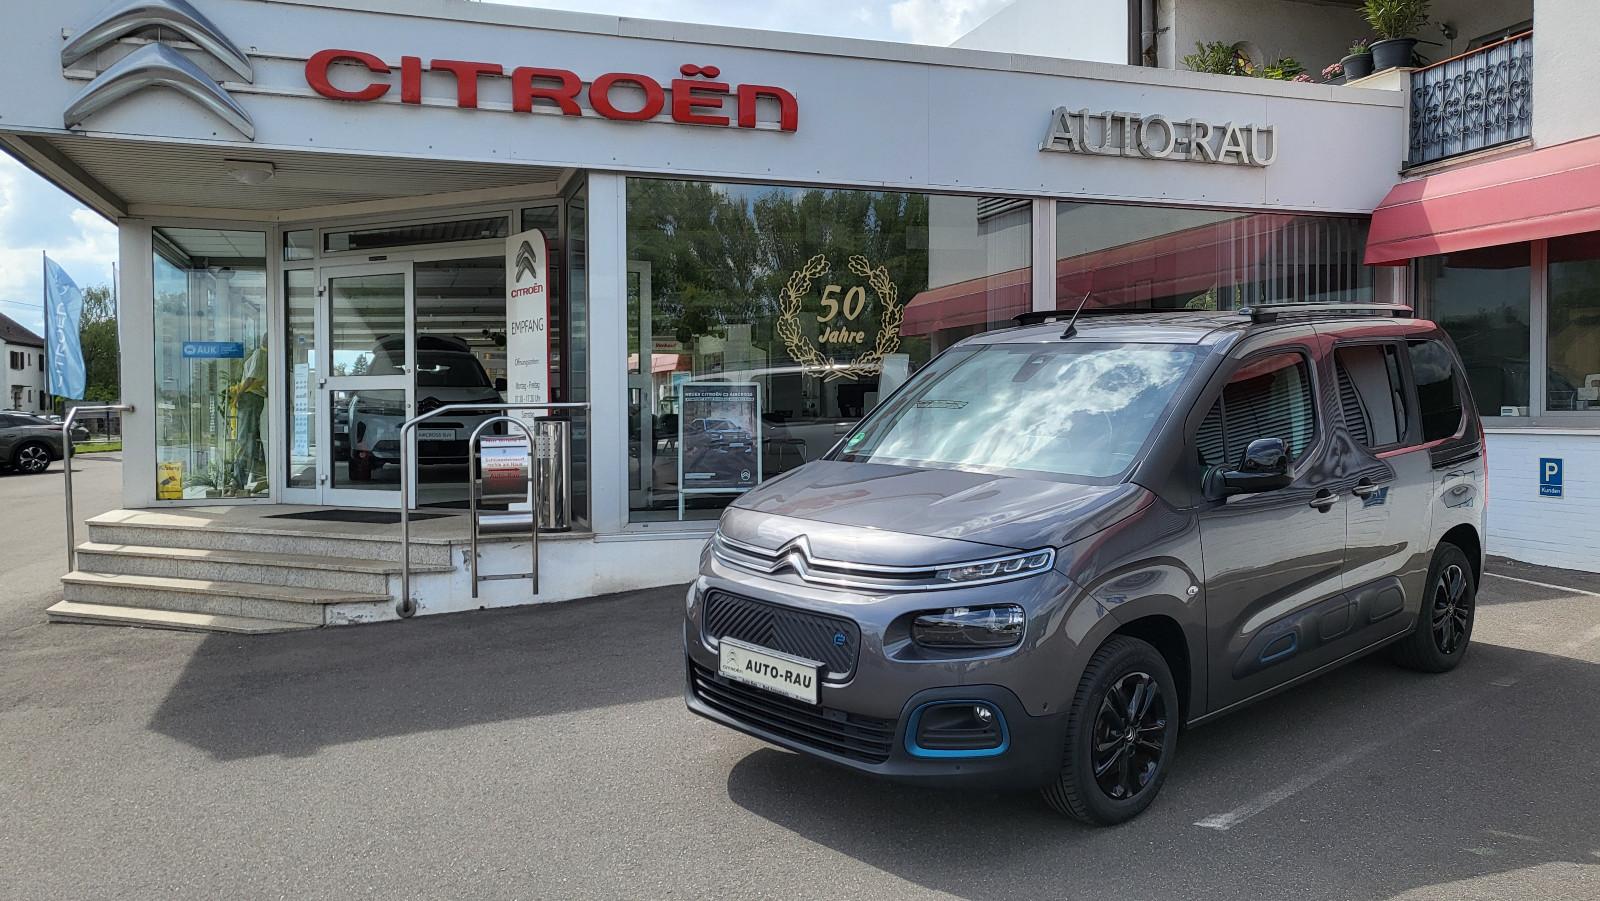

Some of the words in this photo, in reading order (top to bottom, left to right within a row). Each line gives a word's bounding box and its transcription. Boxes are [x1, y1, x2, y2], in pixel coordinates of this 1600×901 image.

[305, 49, 798, 132] CITROËN
[1038, 105, 1280, 168] AUTO-RAU
[511, 282, 544, 298] CITROËN
[816, 284, 866, 323] 50
[511, 317, 544, 335] EMPFANG
[818, 326, 865, 344] Jahre
[197, 345, 217, 355] AUK
[1545, 462, 1558, 482] P
[745, 659, 812, 689] AUTO-RAU
